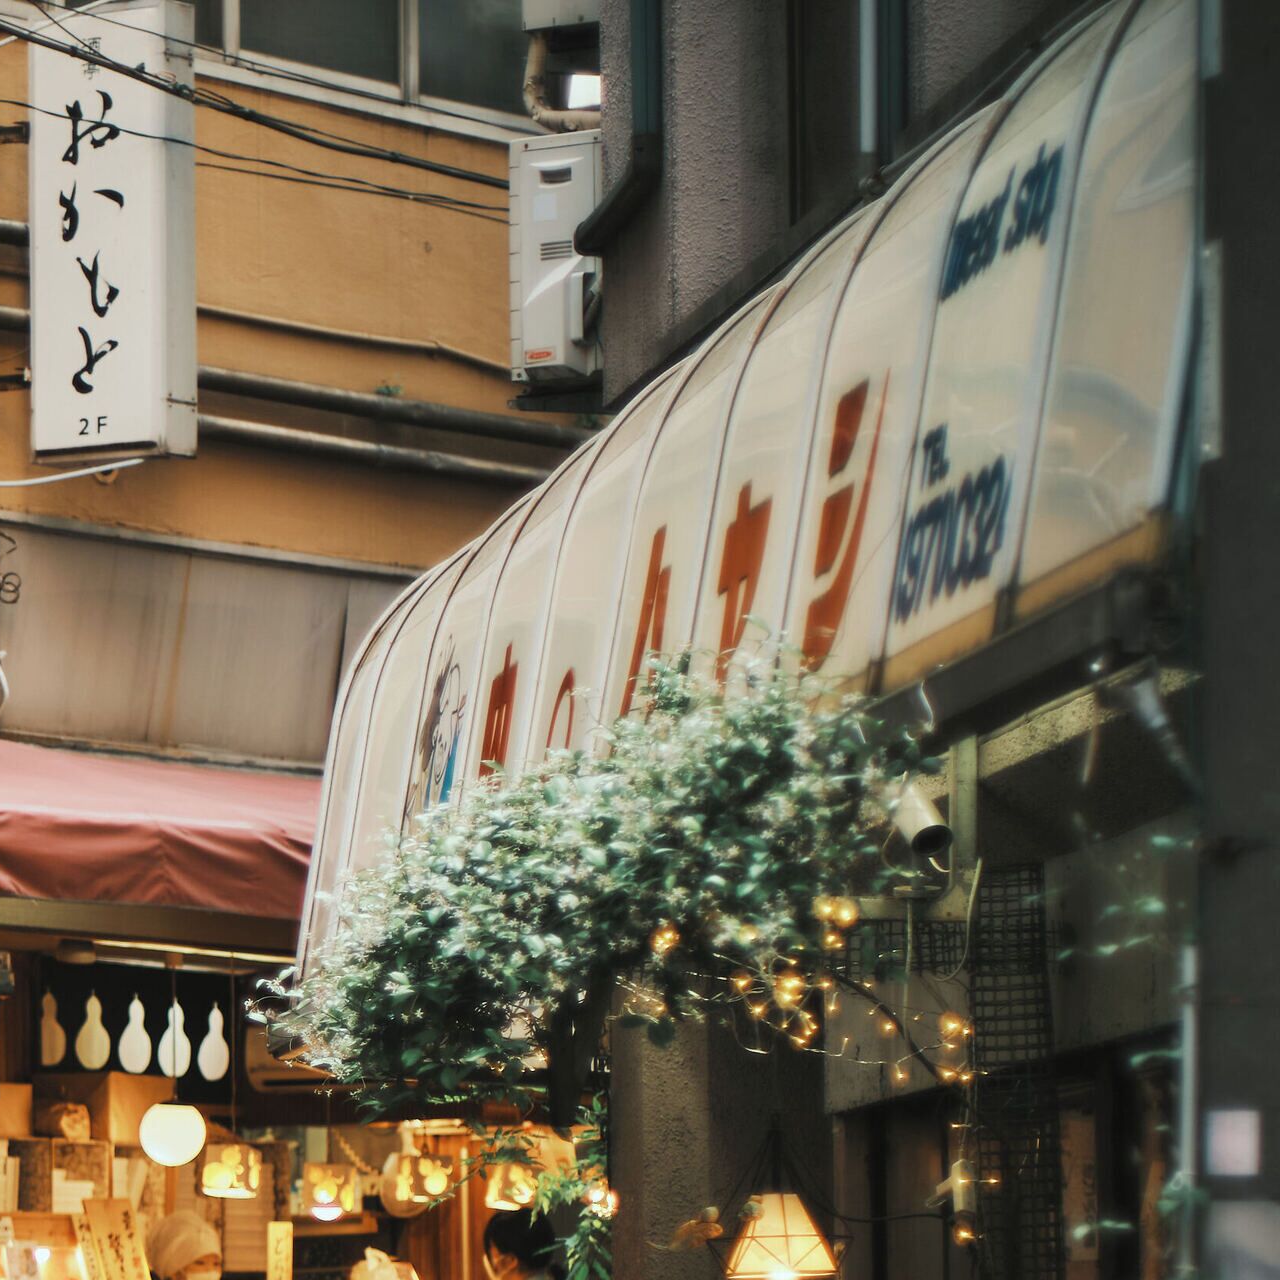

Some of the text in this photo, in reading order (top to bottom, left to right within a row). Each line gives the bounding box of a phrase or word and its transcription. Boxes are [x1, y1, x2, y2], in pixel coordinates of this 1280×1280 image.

[58, 89, 124, 394] おかもと
[78, 415, 108, 436] 2F
